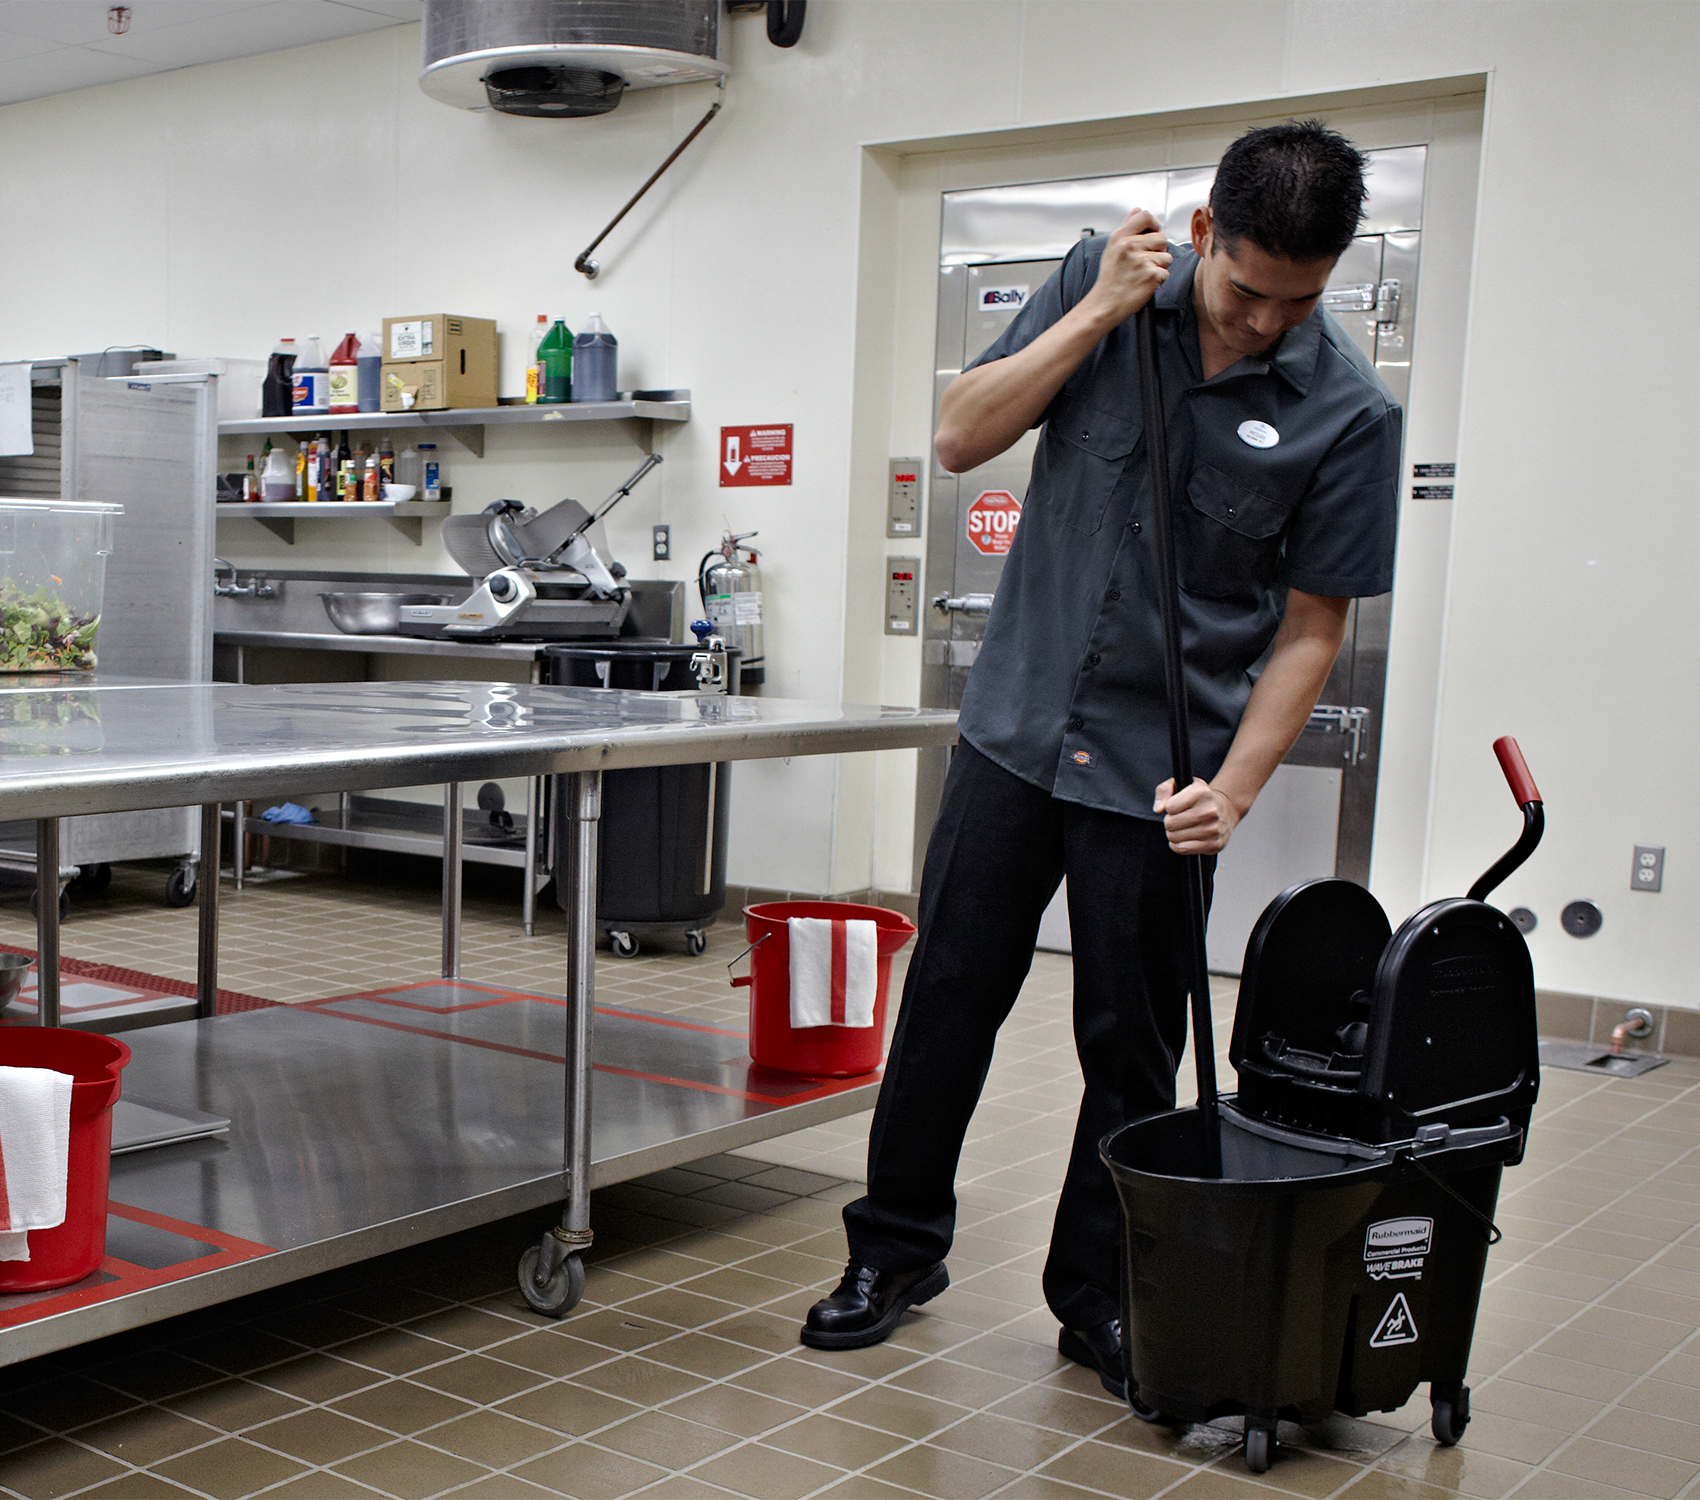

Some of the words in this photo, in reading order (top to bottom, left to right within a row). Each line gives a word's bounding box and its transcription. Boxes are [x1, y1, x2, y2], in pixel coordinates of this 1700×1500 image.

[984, 289, 1026, 305] Bally
[756, 429, 787, 437] WARNING
[969, 510, 1021, 534] STOP
[1371, 1226, 1427, 1240] Rubbermaid
[1367, 1247, 1400, 1257] Commercial
[1401, 1245, 1427, 1253] Products
